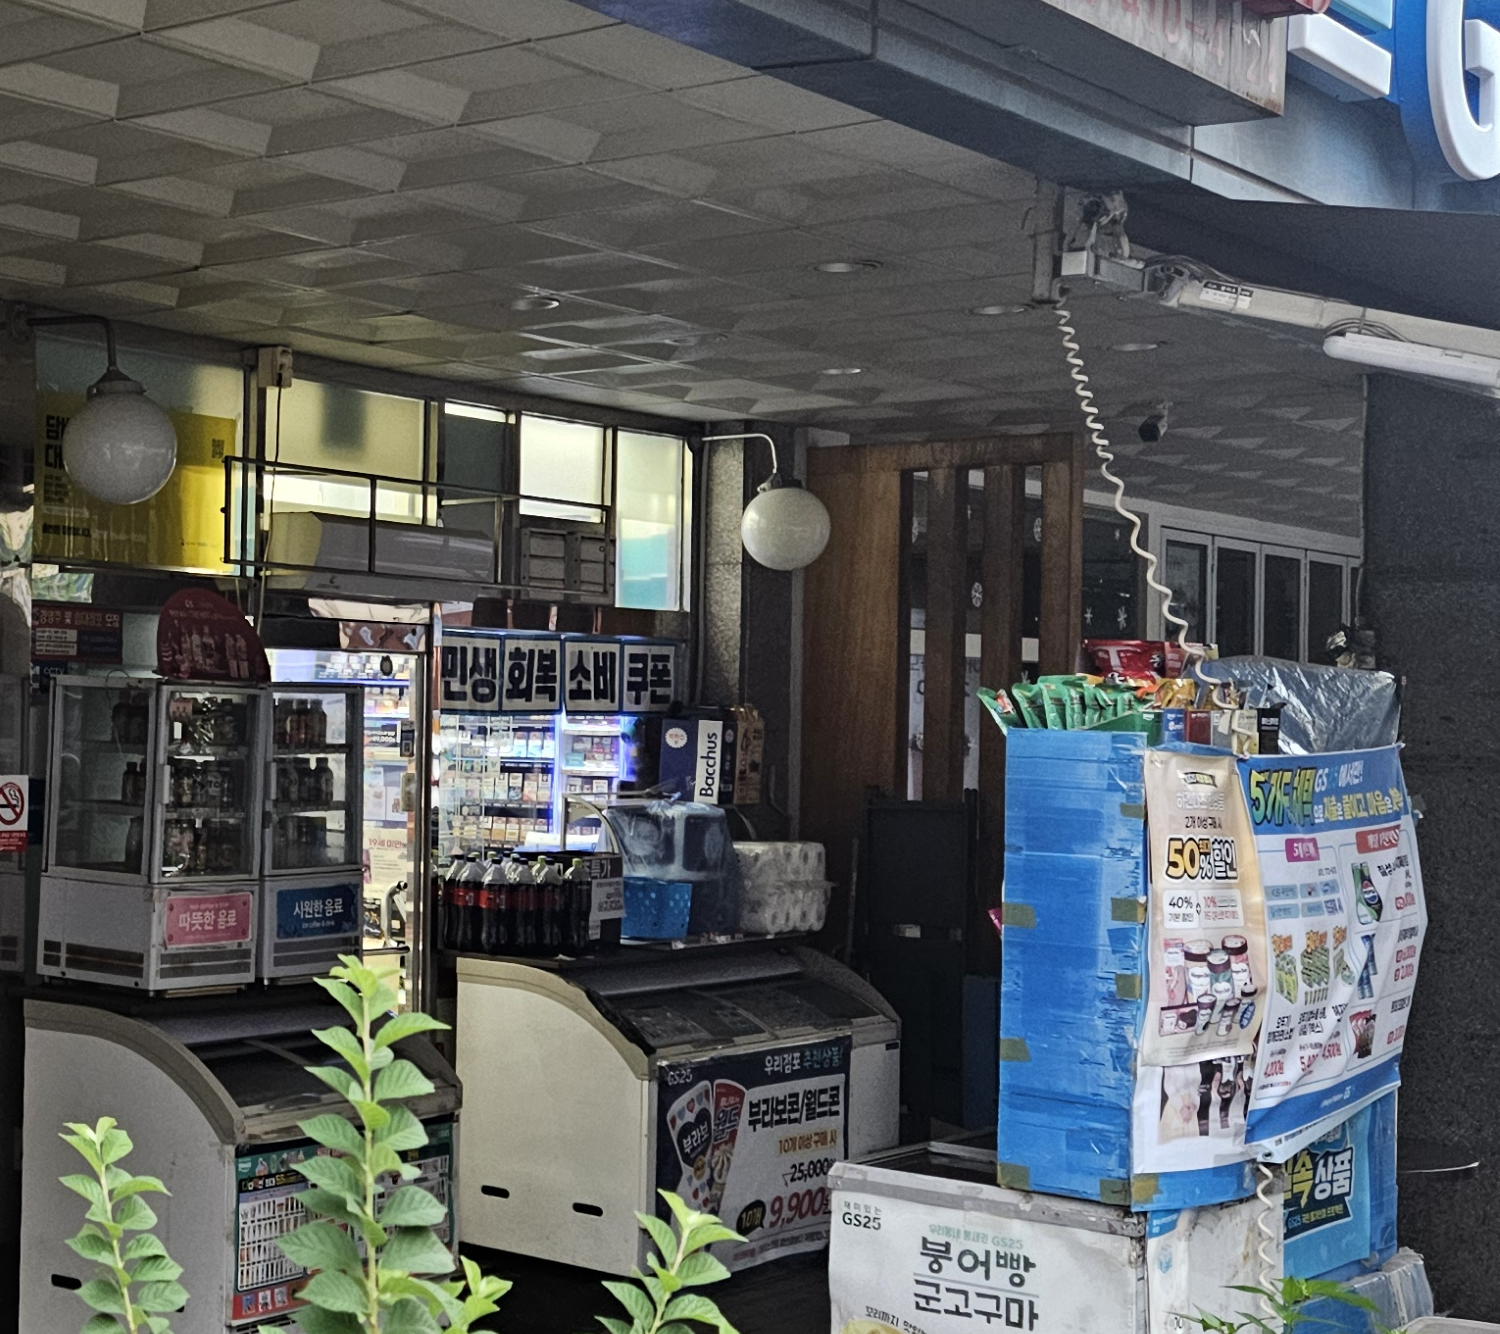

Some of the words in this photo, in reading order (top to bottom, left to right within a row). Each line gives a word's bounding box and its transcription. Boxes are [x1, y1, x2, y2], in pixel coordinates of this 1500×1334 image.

[441, 646, 497, 704] 민생
[506, 646, 558, 703] 회복
[569, 650, 616, 704] 소비
[627, 653, 672, 706] 쿠폰
[699, 732, 718, 797] Bacchus
[294, 899, 323, 919] 시원한
[325, 898, 344, 917] 음료
[1169, 896, 1193, 909] 40%
[179, 911, 215, 932] 따뜻한
[217, 910, 237, 930] 음료
[764, 1053, 800, 1076] 우리점포
[667, 1068, 693, 1086] GS25
[748, 1085, 840, 1132] 부라보콘/월드콘
[683, 1121, 710, 1153] 부라보
[779, 1137, 797, 1154] 10개
[842, 1212, 882, 1230] GS25
[991, 1235, 1024, 1251] GS25
[920, 1236, 1037, 1288] 붕어빵
[913, 1279, 1039, 1331] 군고구마
[865, 1306, 899, 1327] 꼬리까지
